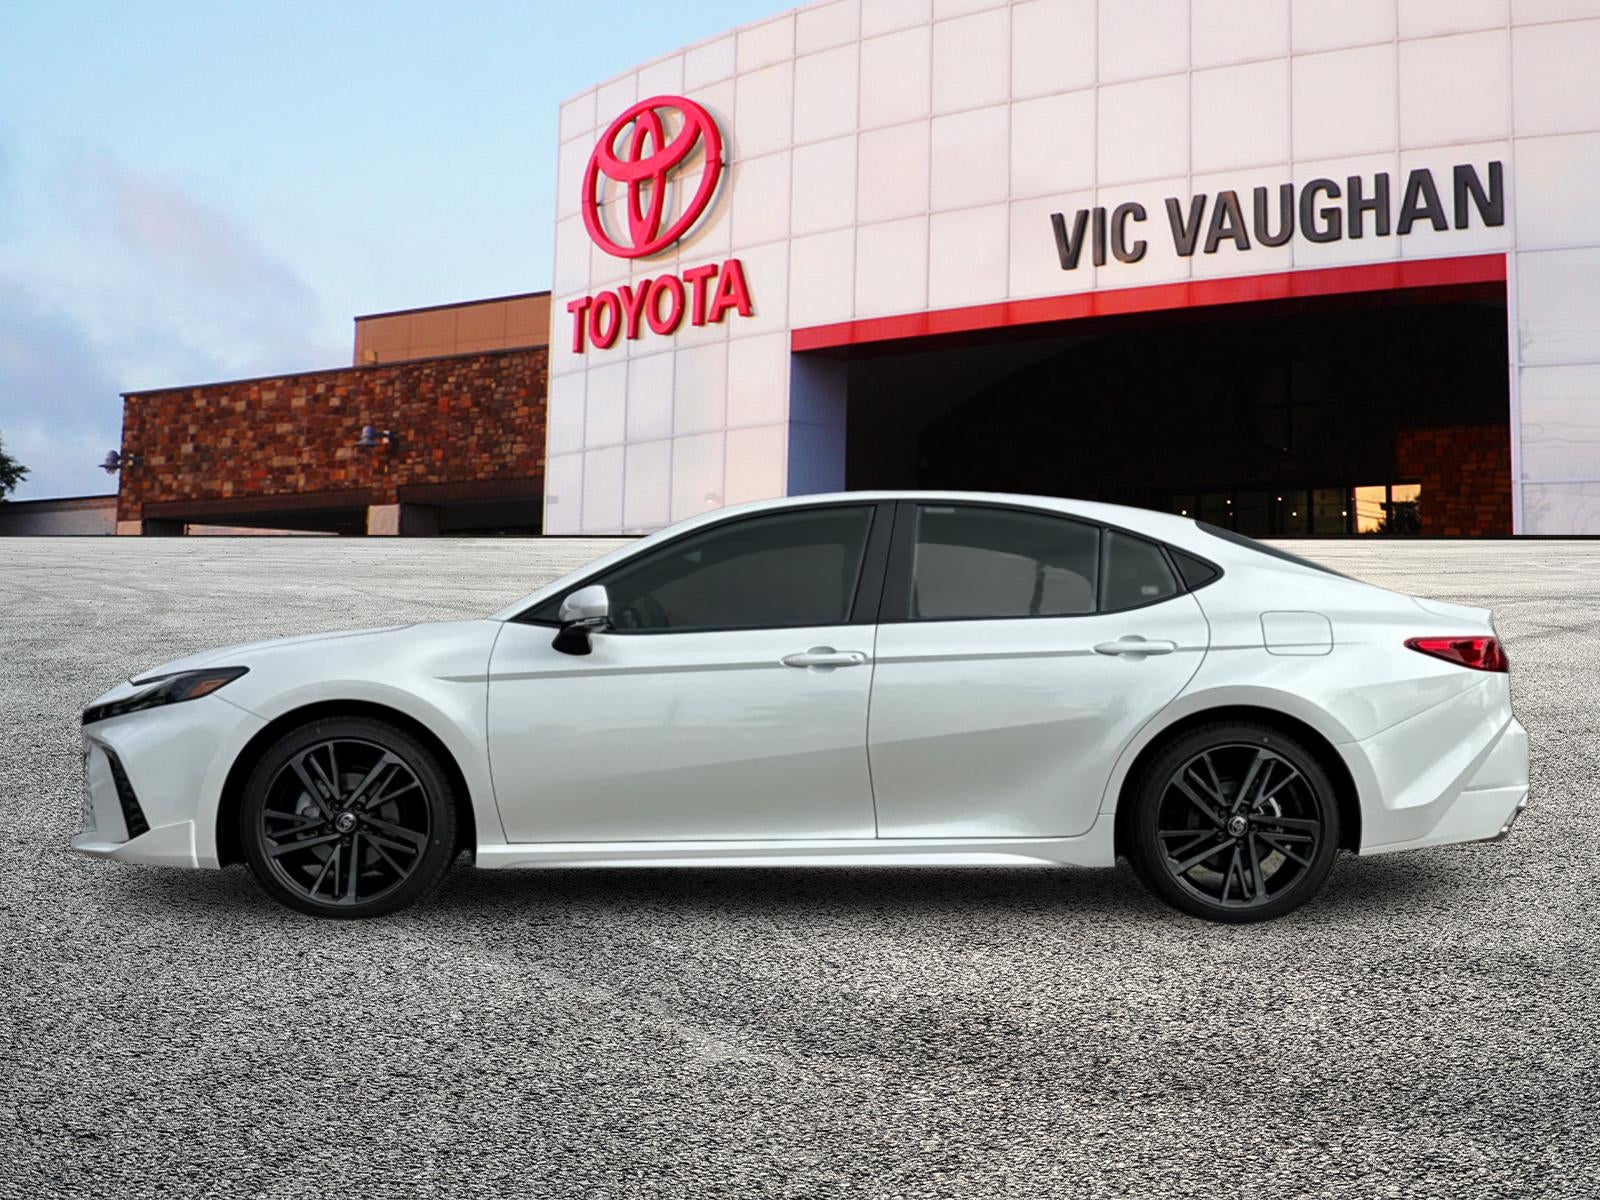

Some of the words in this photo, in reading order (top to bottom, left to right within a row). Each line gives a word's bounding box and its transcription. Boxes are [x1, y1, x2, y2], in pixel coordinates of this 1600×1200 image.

[1050, 202, 1147, 270] VIC
[1165, 161, 1505, 257] VAUGHAN
[567, 259, 753, 353] TOYOTA
